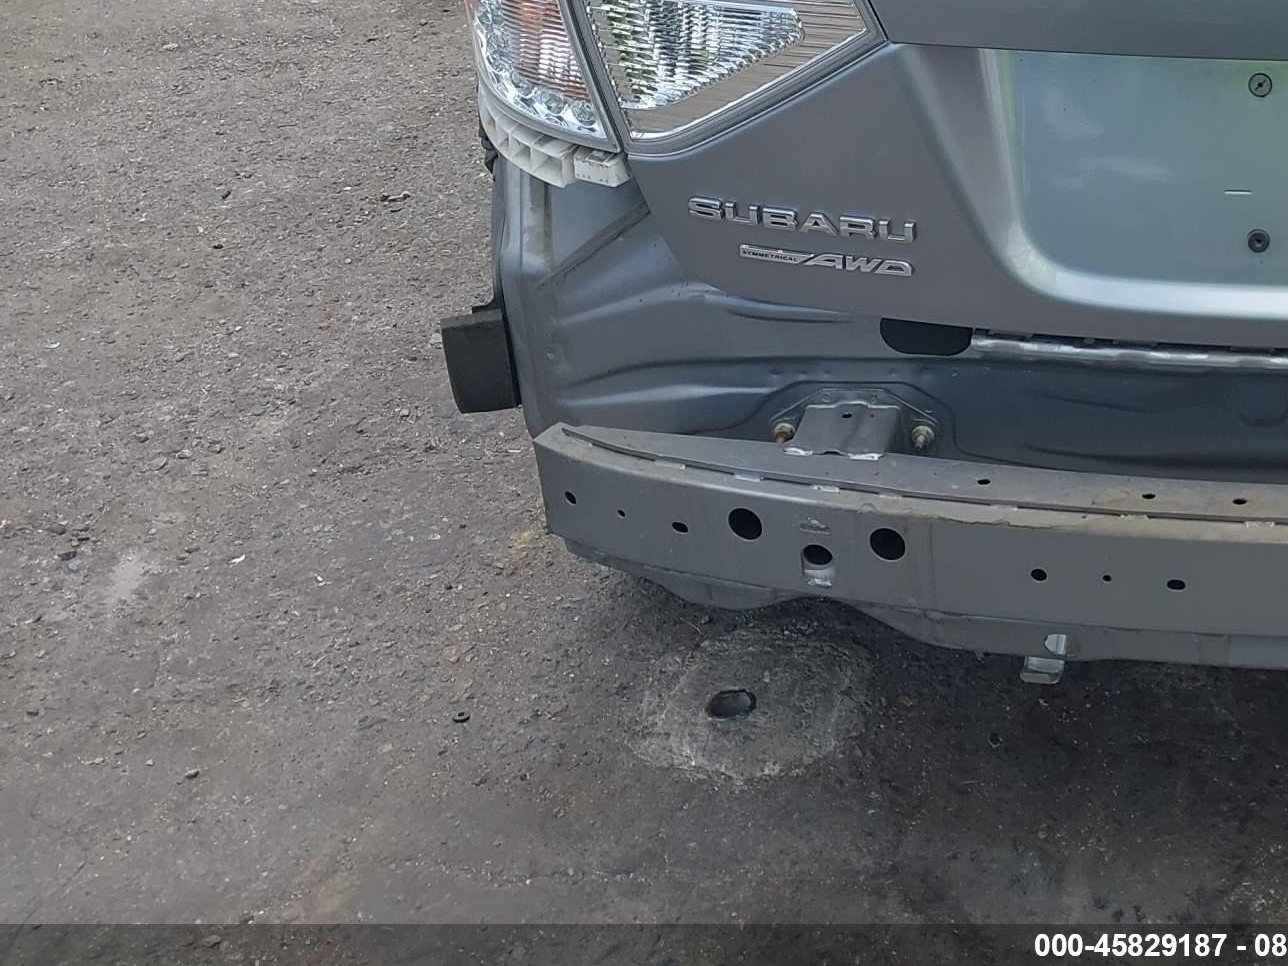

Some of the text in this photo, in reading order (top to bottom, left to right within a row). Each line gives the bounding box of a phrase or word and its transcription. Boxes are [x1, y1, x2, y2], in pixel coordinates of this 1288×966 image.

[688, 195, 918, 244] SUBARU
[741, 249, 915, 277] SYMMETRICAL AWD
